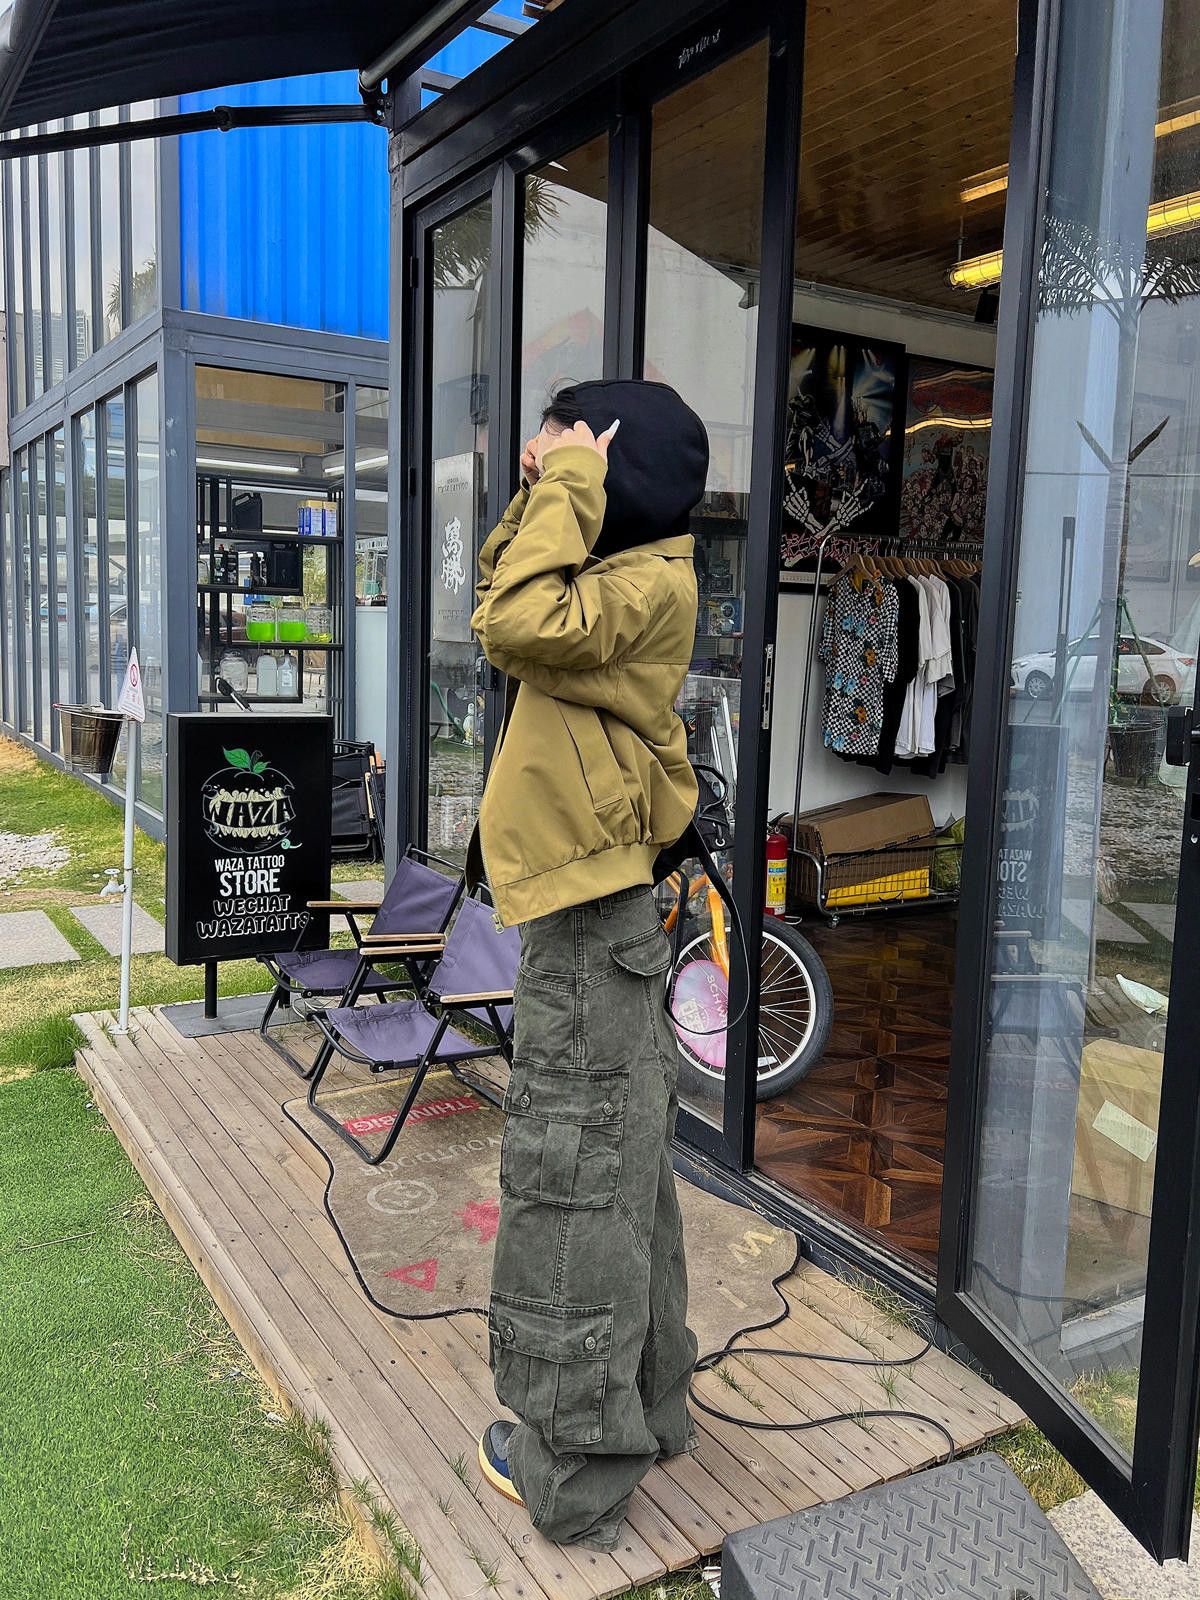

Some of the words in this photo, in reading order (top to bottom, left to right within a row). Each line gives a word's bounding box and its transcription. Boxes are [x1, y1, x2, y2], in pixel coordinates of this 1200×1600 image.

[208, 798, 291, 827] WAZA
[214, 858, 244, 872] WAZA
[247, 855, 285, 869] TATTOO
[219, 868, 280, 896] STORE
[213, 894, 291, 917] WECHAT
[393, 1099, 473, 1120] THIN
[352, 1116, 394, 1132] BIG
